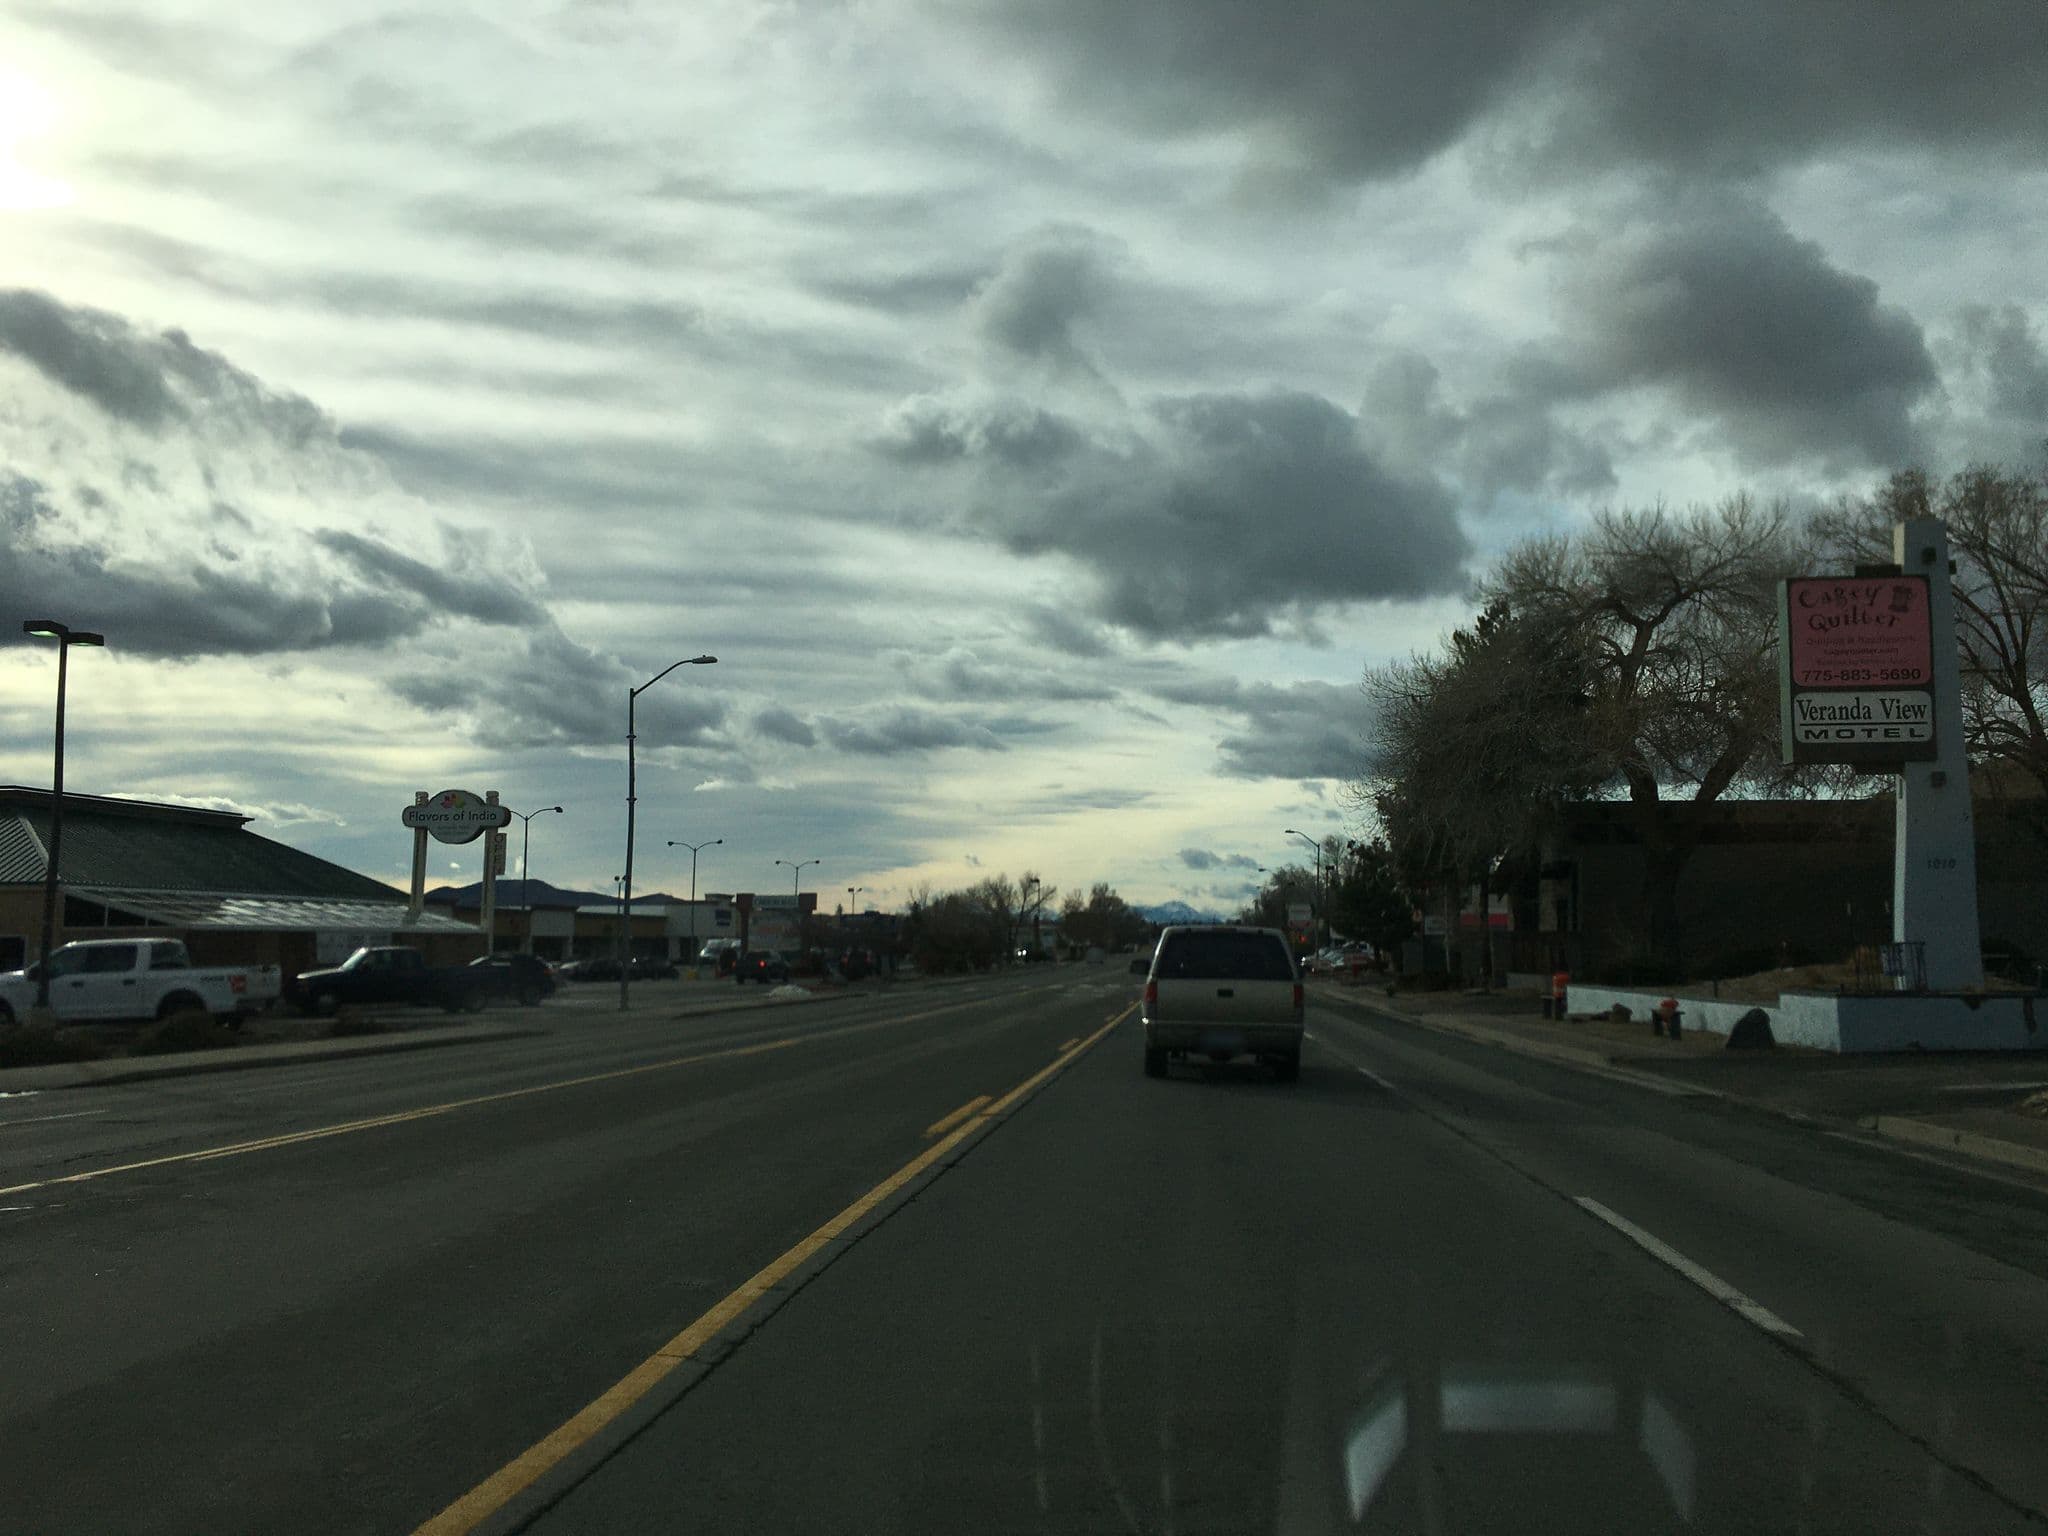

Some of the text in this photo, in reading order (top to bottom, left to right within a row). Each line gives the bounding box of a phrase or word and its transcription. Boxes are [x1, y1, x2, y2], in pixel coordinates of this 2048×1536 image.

[1809, 605, 1898, 632] Quilter
[1802, 668, 1921, 682] 775-883-5690
[1796, 697, 1927, 721] Veranda View
[1804, 728, 1925, 740] MOTEL
[409, 811, 497, 822] Flavors of India
